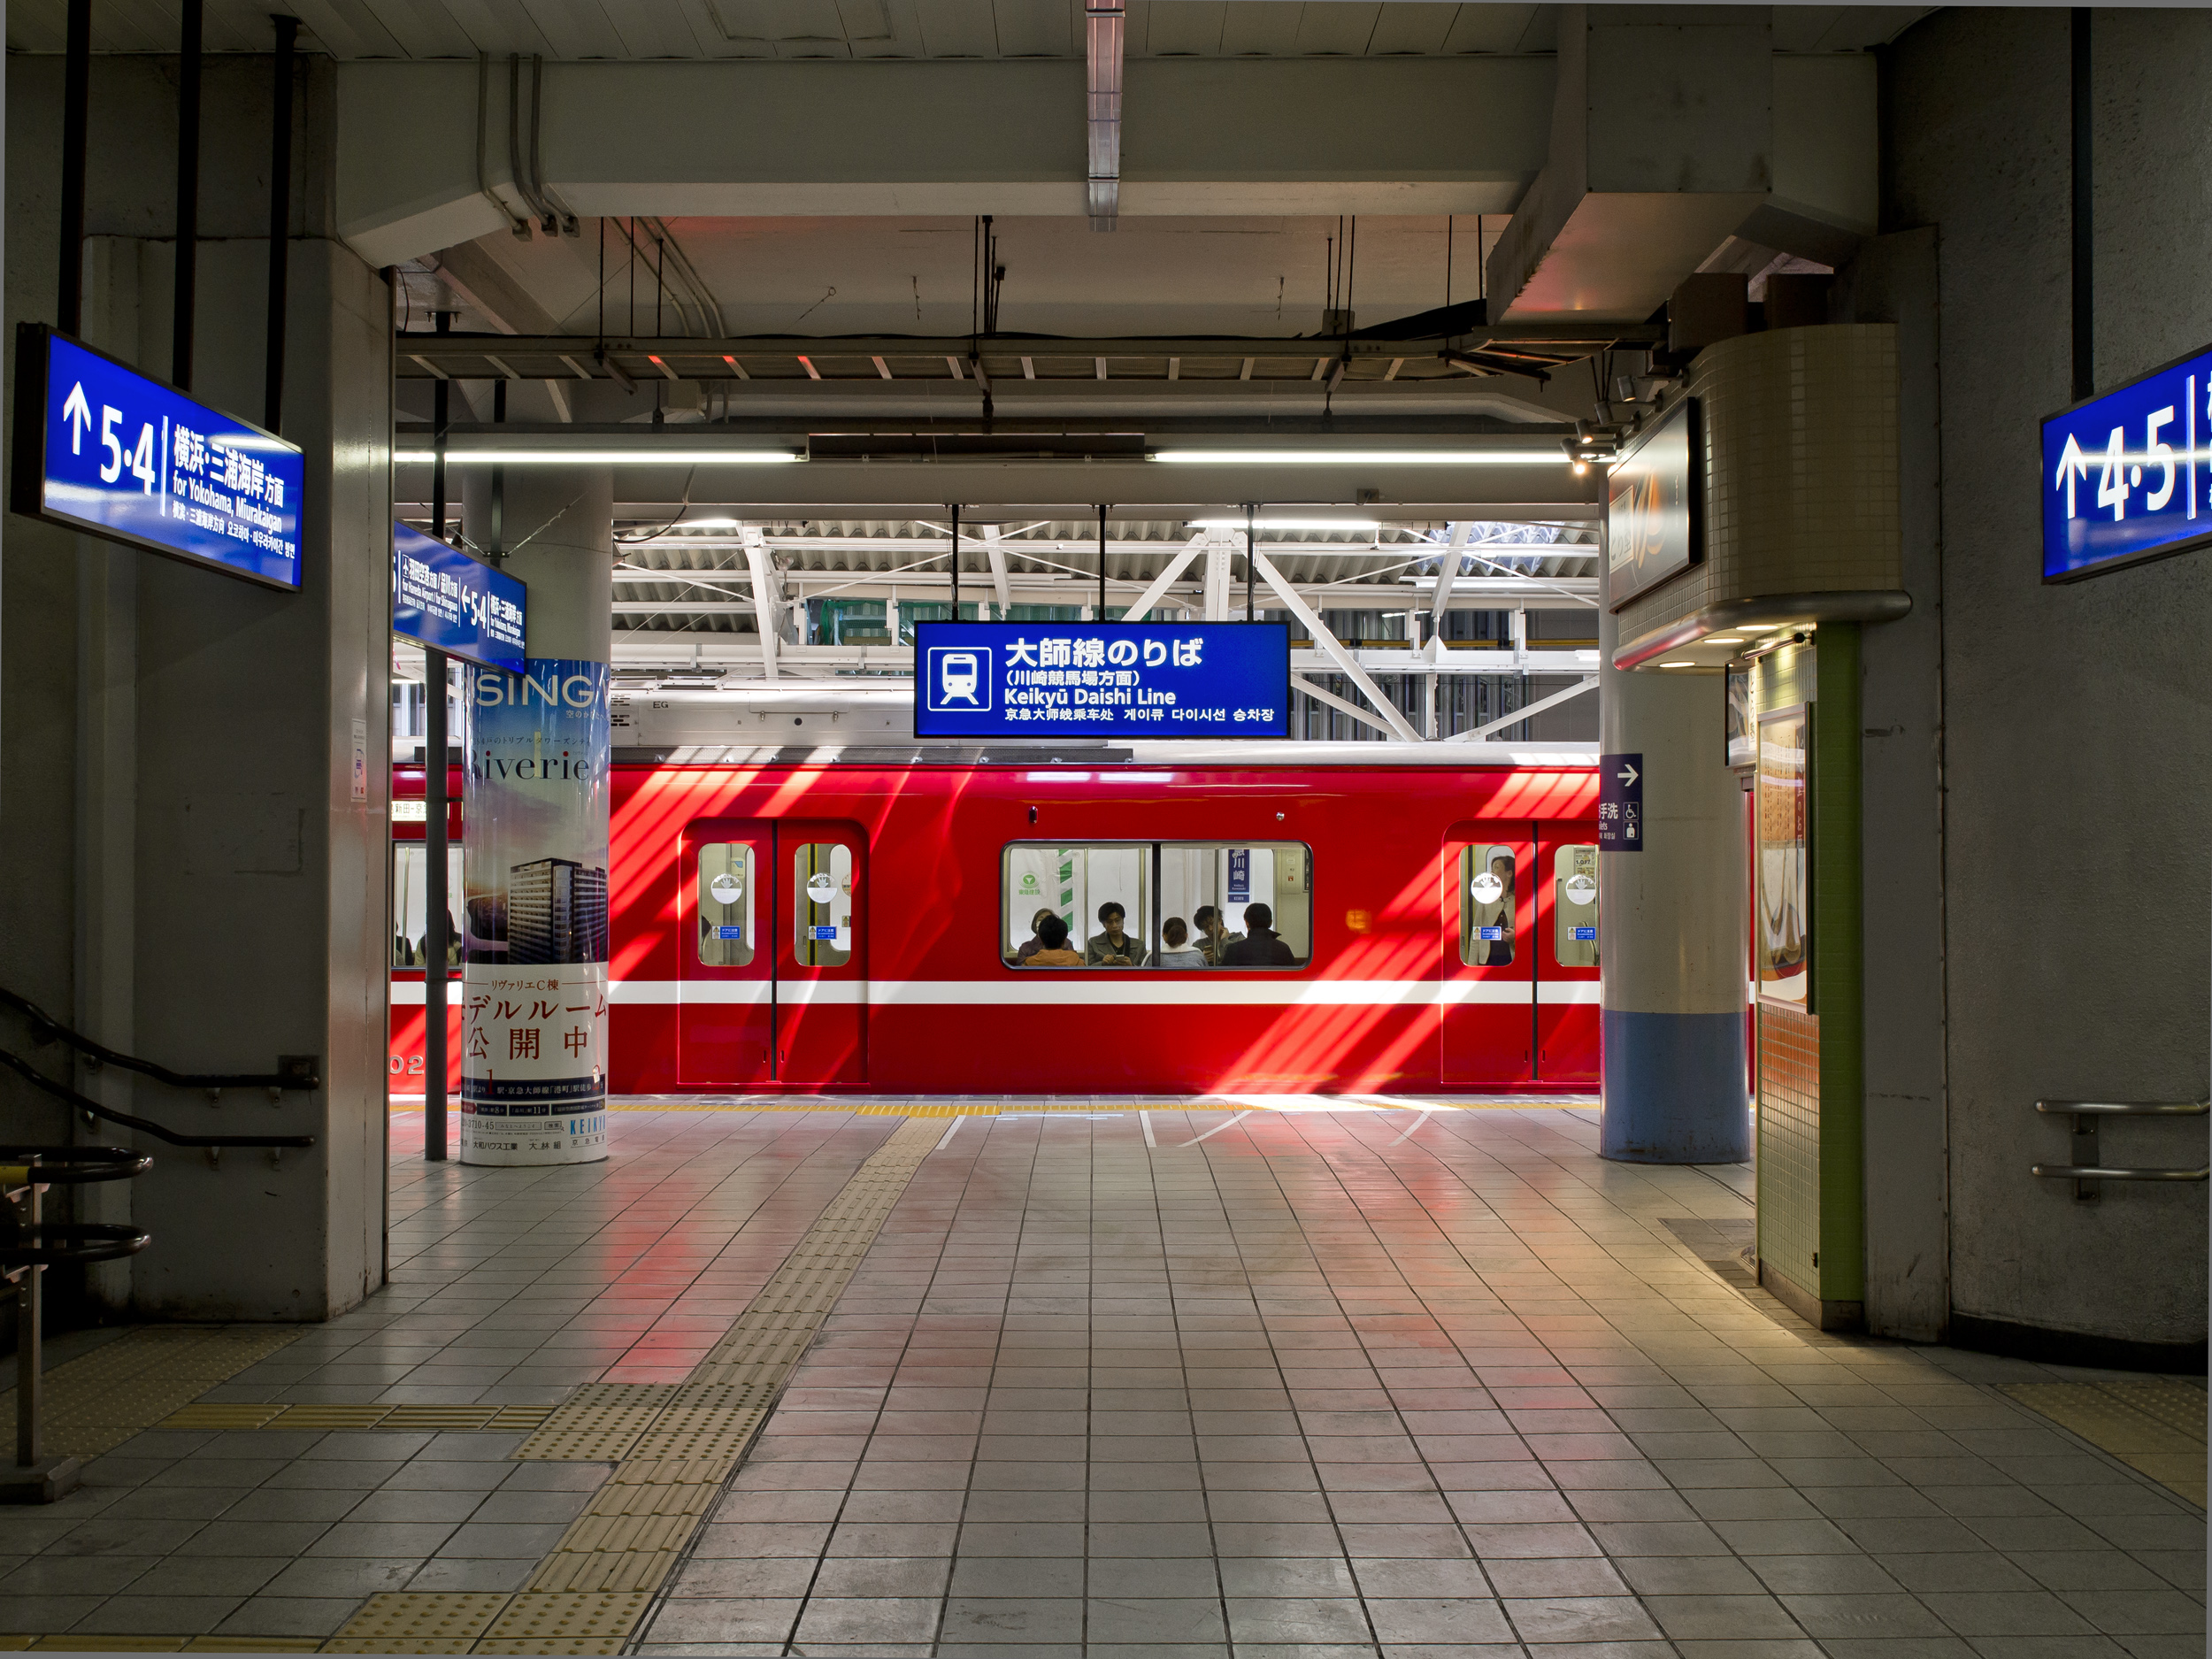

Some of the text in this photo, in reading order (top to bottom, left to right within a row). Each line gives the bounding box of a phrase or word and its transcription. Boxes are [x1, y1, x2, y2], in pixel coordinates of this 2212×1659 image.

[173, 469, 282, 534] for Yokohama, Miurakaigan
[1005, 637, 1204, 668] 大師線のりば
[1004, 687, 1176, 708] Keikyū Daishi Line
[1004, 707, 1275, 722] 京急大师线乘车处 게이큐 다이시선 승차장
[472, 1141, 518, 1151] 大和ハウス工業
